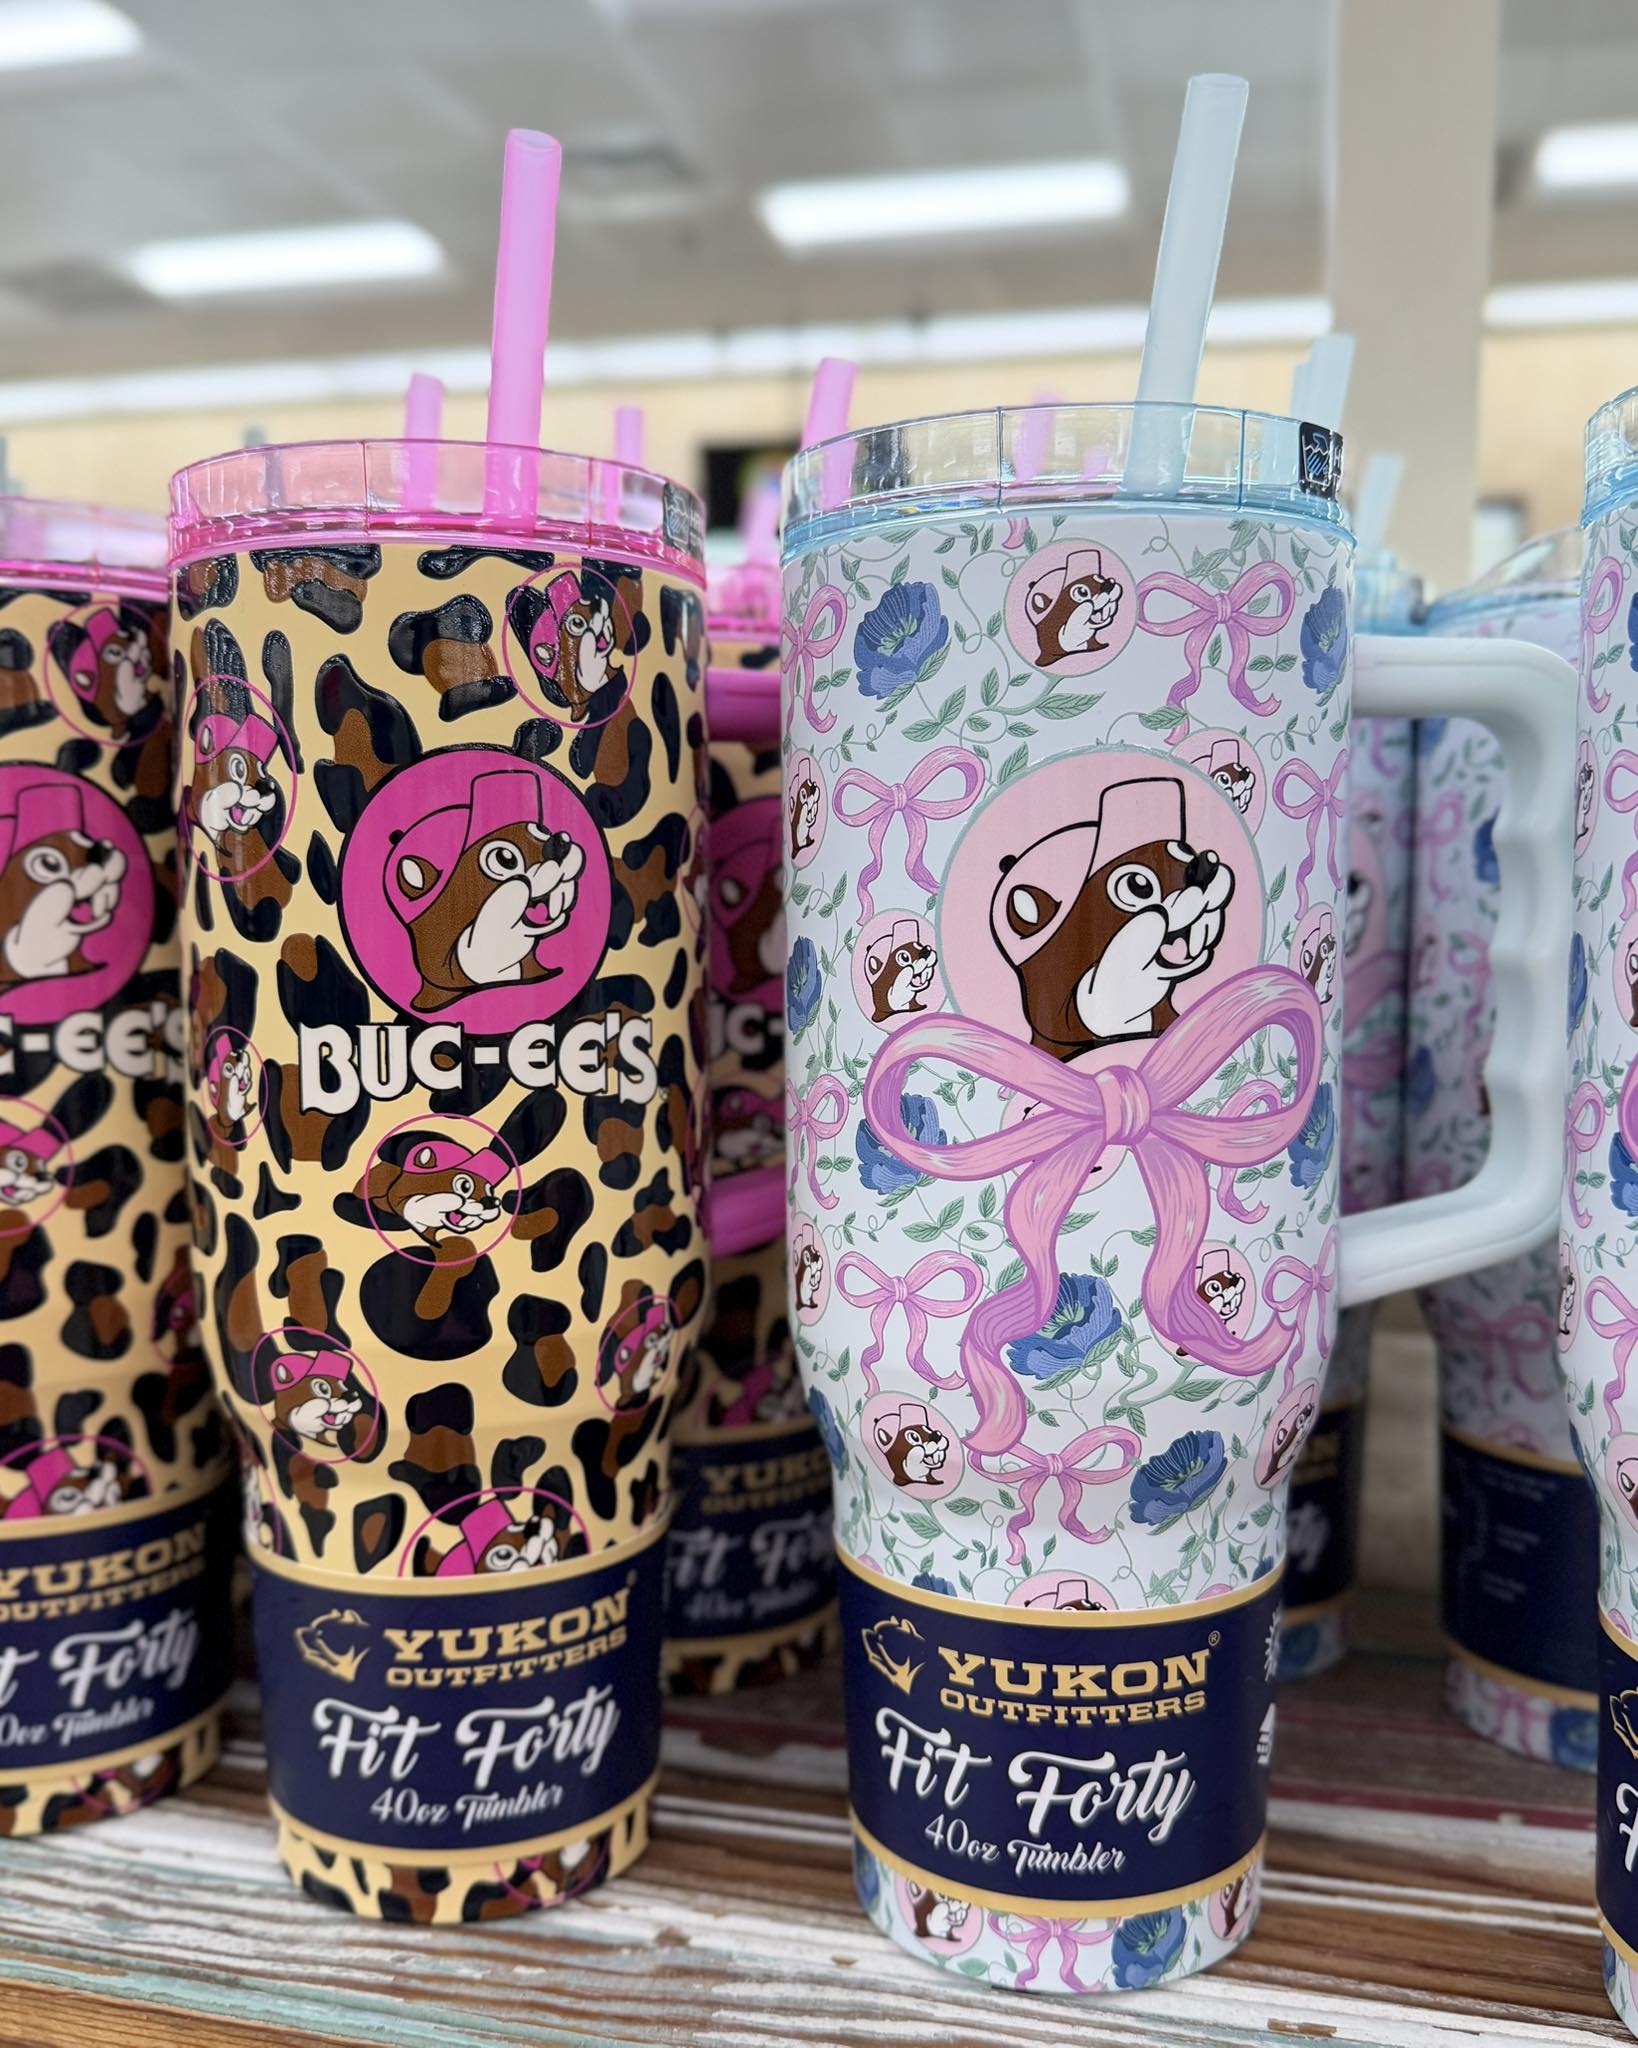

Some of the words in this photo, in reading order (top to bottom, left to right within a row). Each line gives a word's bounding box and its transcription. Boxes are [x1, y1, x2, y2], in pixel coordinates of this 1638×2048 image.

[300, 1010, 658, 1116] BUC-EE'S
[51, 1607, 198, 1708] Forty
[386, 1625, 627, 1688] OUTFITTERS
[313, 1698, 442, 1781] Fit
[455, 1683, 621, 1790] Forty
[939, 1687, 1206, 1726] OUTFITTERS
[370, 1788, 449, 1826] 40oz
[454, 1777, 564, 1832] Tumbler
[875, 1706, 992, 1808] Fit
[1007, 1748, 1196, 1844] Forty
[924, 1814, 999, 1862] 40oz
[1006, 1839, 1125, 1877] Tumbler
